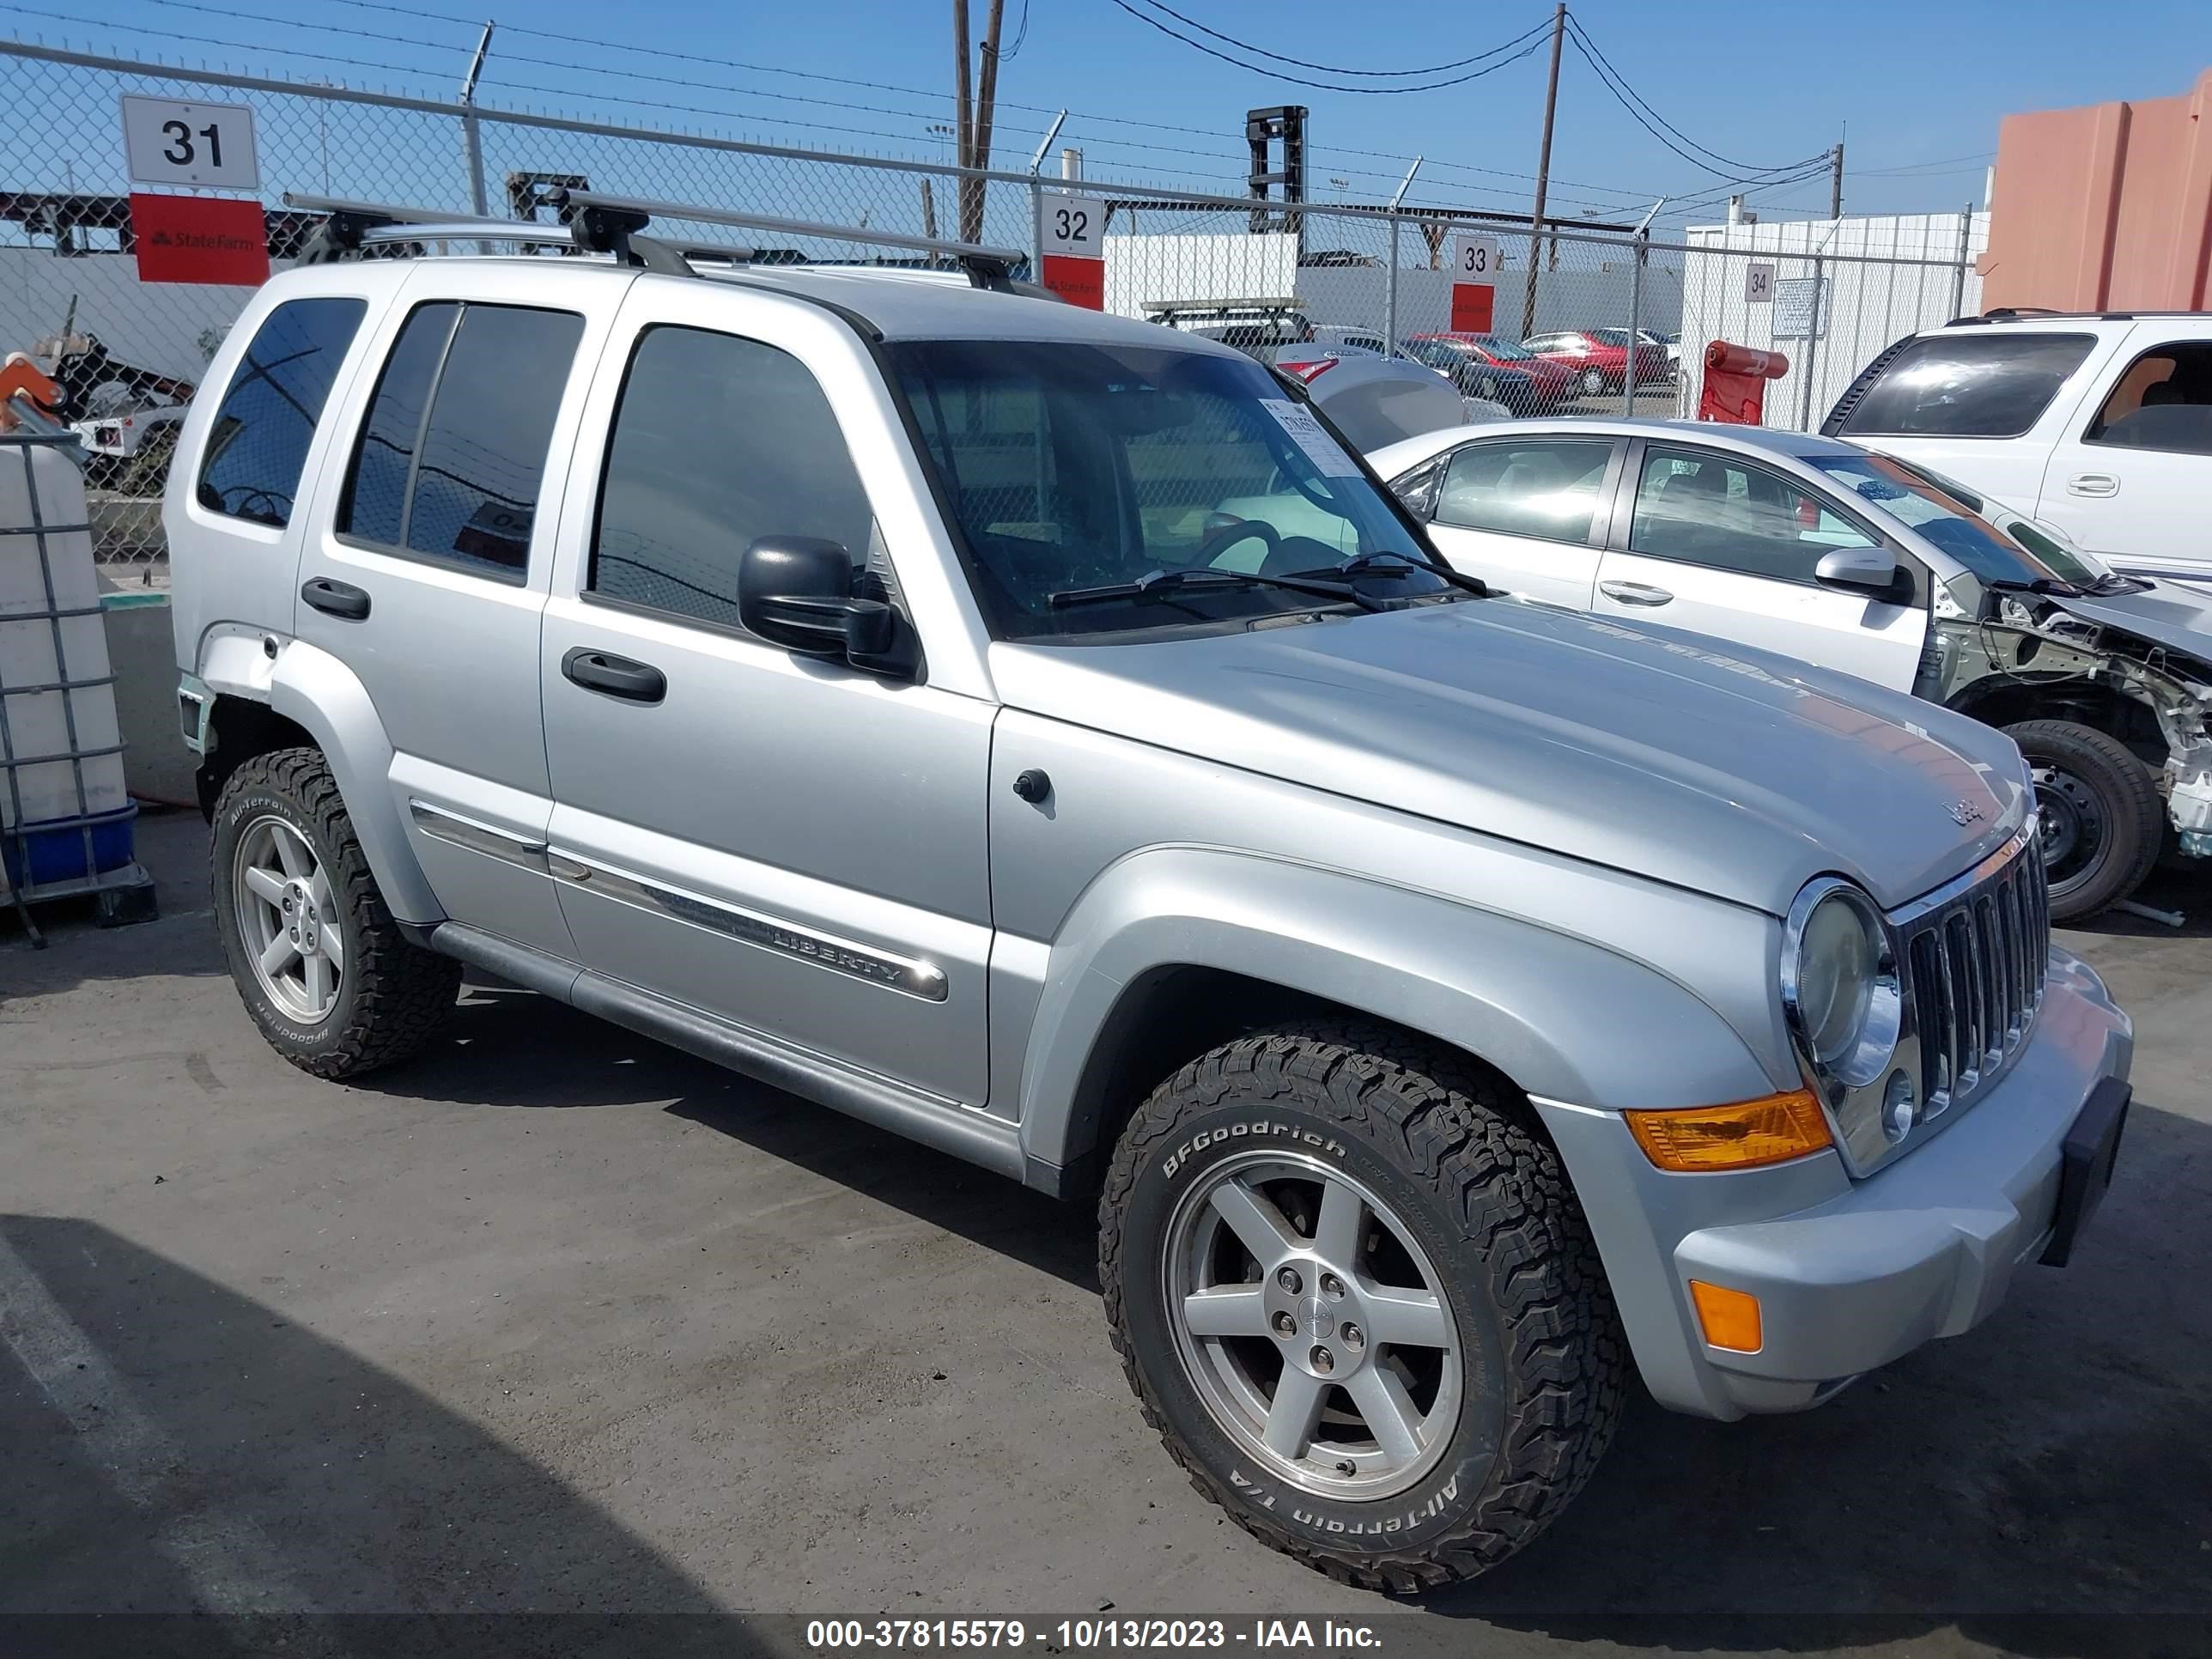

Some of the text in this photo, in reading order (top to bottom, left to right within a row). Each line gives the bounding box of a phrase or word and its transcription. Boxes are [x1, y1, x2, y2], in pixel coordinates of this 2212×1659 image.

[161, 119, 222, 168] 31
[1054, 209, 1088, 242] 32
[1465, 246, 1486, 272] 33
[1752, 273, 1766, 294] 34
[773, 933, 901, 981] LIBERTY
[1162, 1119, 1347, 1180] BFGoodrich
[1229, 1469, 1277, 1511] T/A
